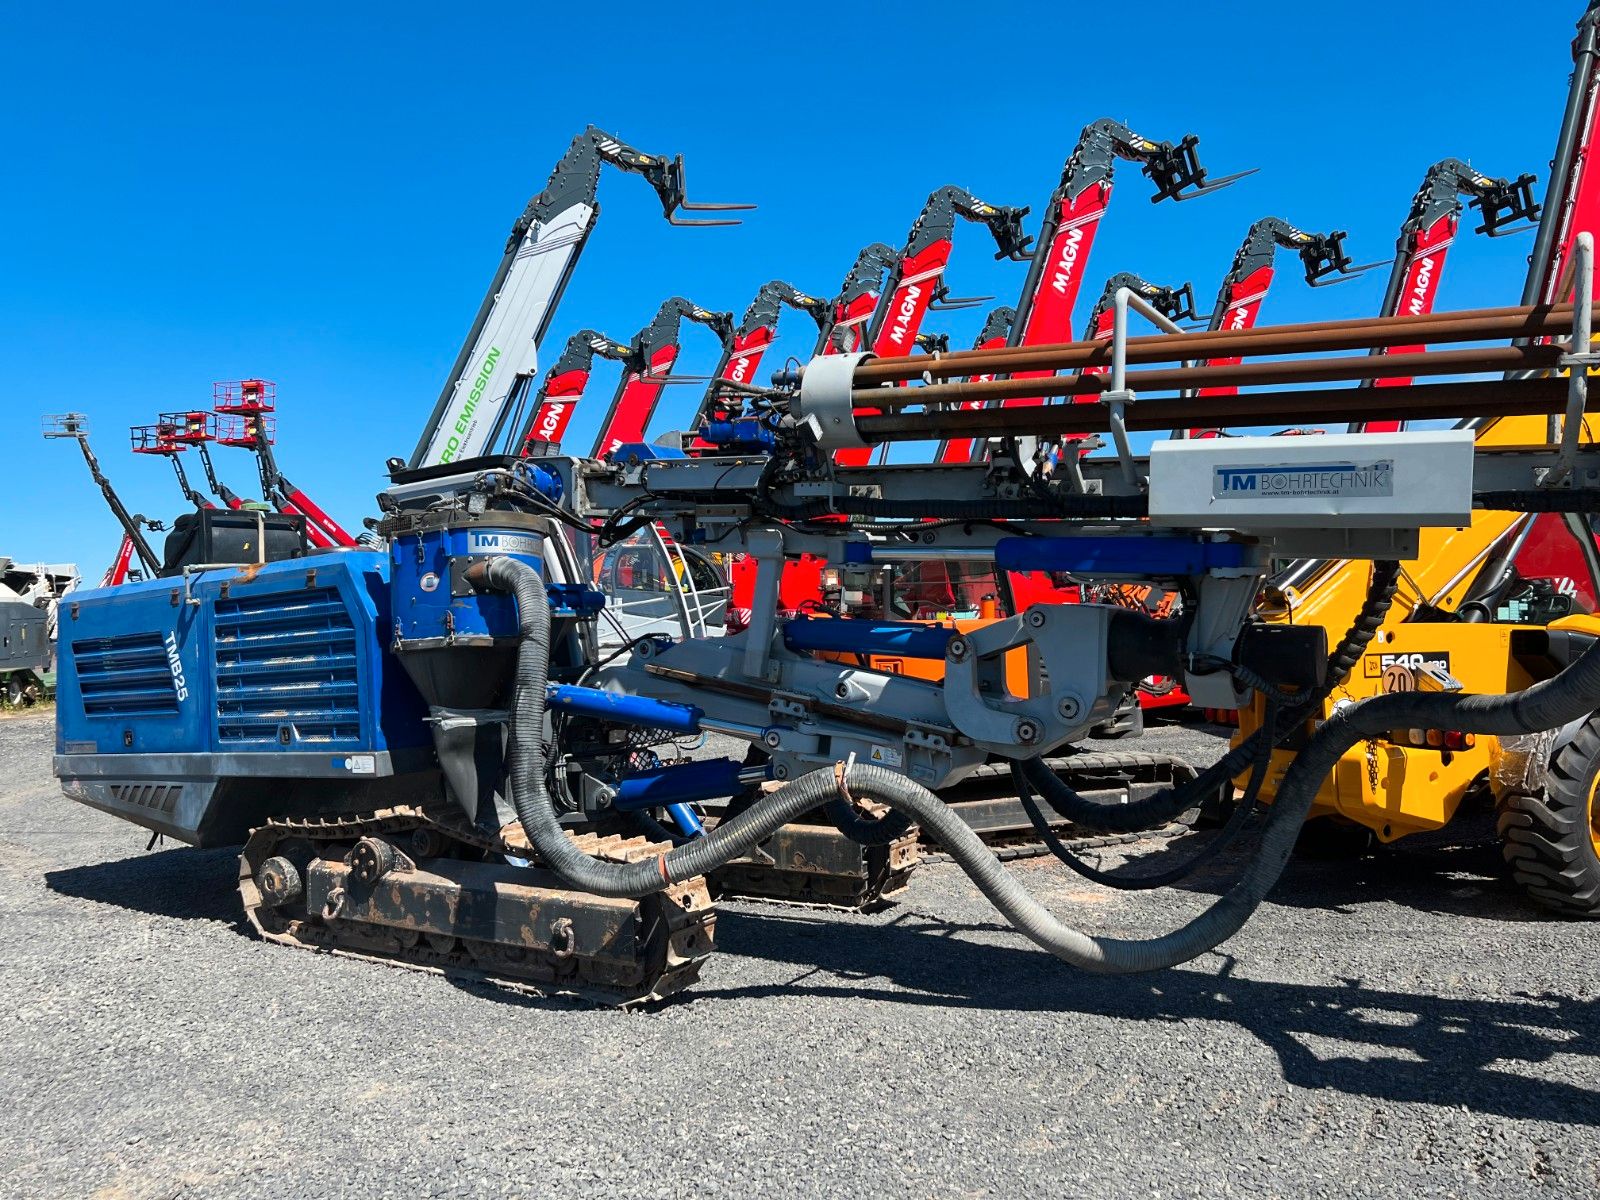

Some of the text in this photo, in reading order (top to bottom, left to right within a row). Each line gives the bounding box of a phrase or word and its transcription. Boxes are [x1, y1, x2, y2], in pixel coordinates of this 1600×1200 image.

[1052, 228, 1084, 294] MAGNI
[1409, 257, 1435, 315] MAGNI
[890, 285, 922, 345] MAGNI
[1230, 307, 1249, 331] GNI
[732, 357, 750, 382] GNI
[438, 347, 502, 464] RO EMISSION
[539, 402, 565, 441] AGNI
[1217, 468, 1385, 491] TM BOHRTECHNIK
[470, 531, 499, 547] TM
[165, 630, 189, 702] TMB25
[1381, 653, 1424, 672] 540
[1387, 671, 1407, 692] 20
